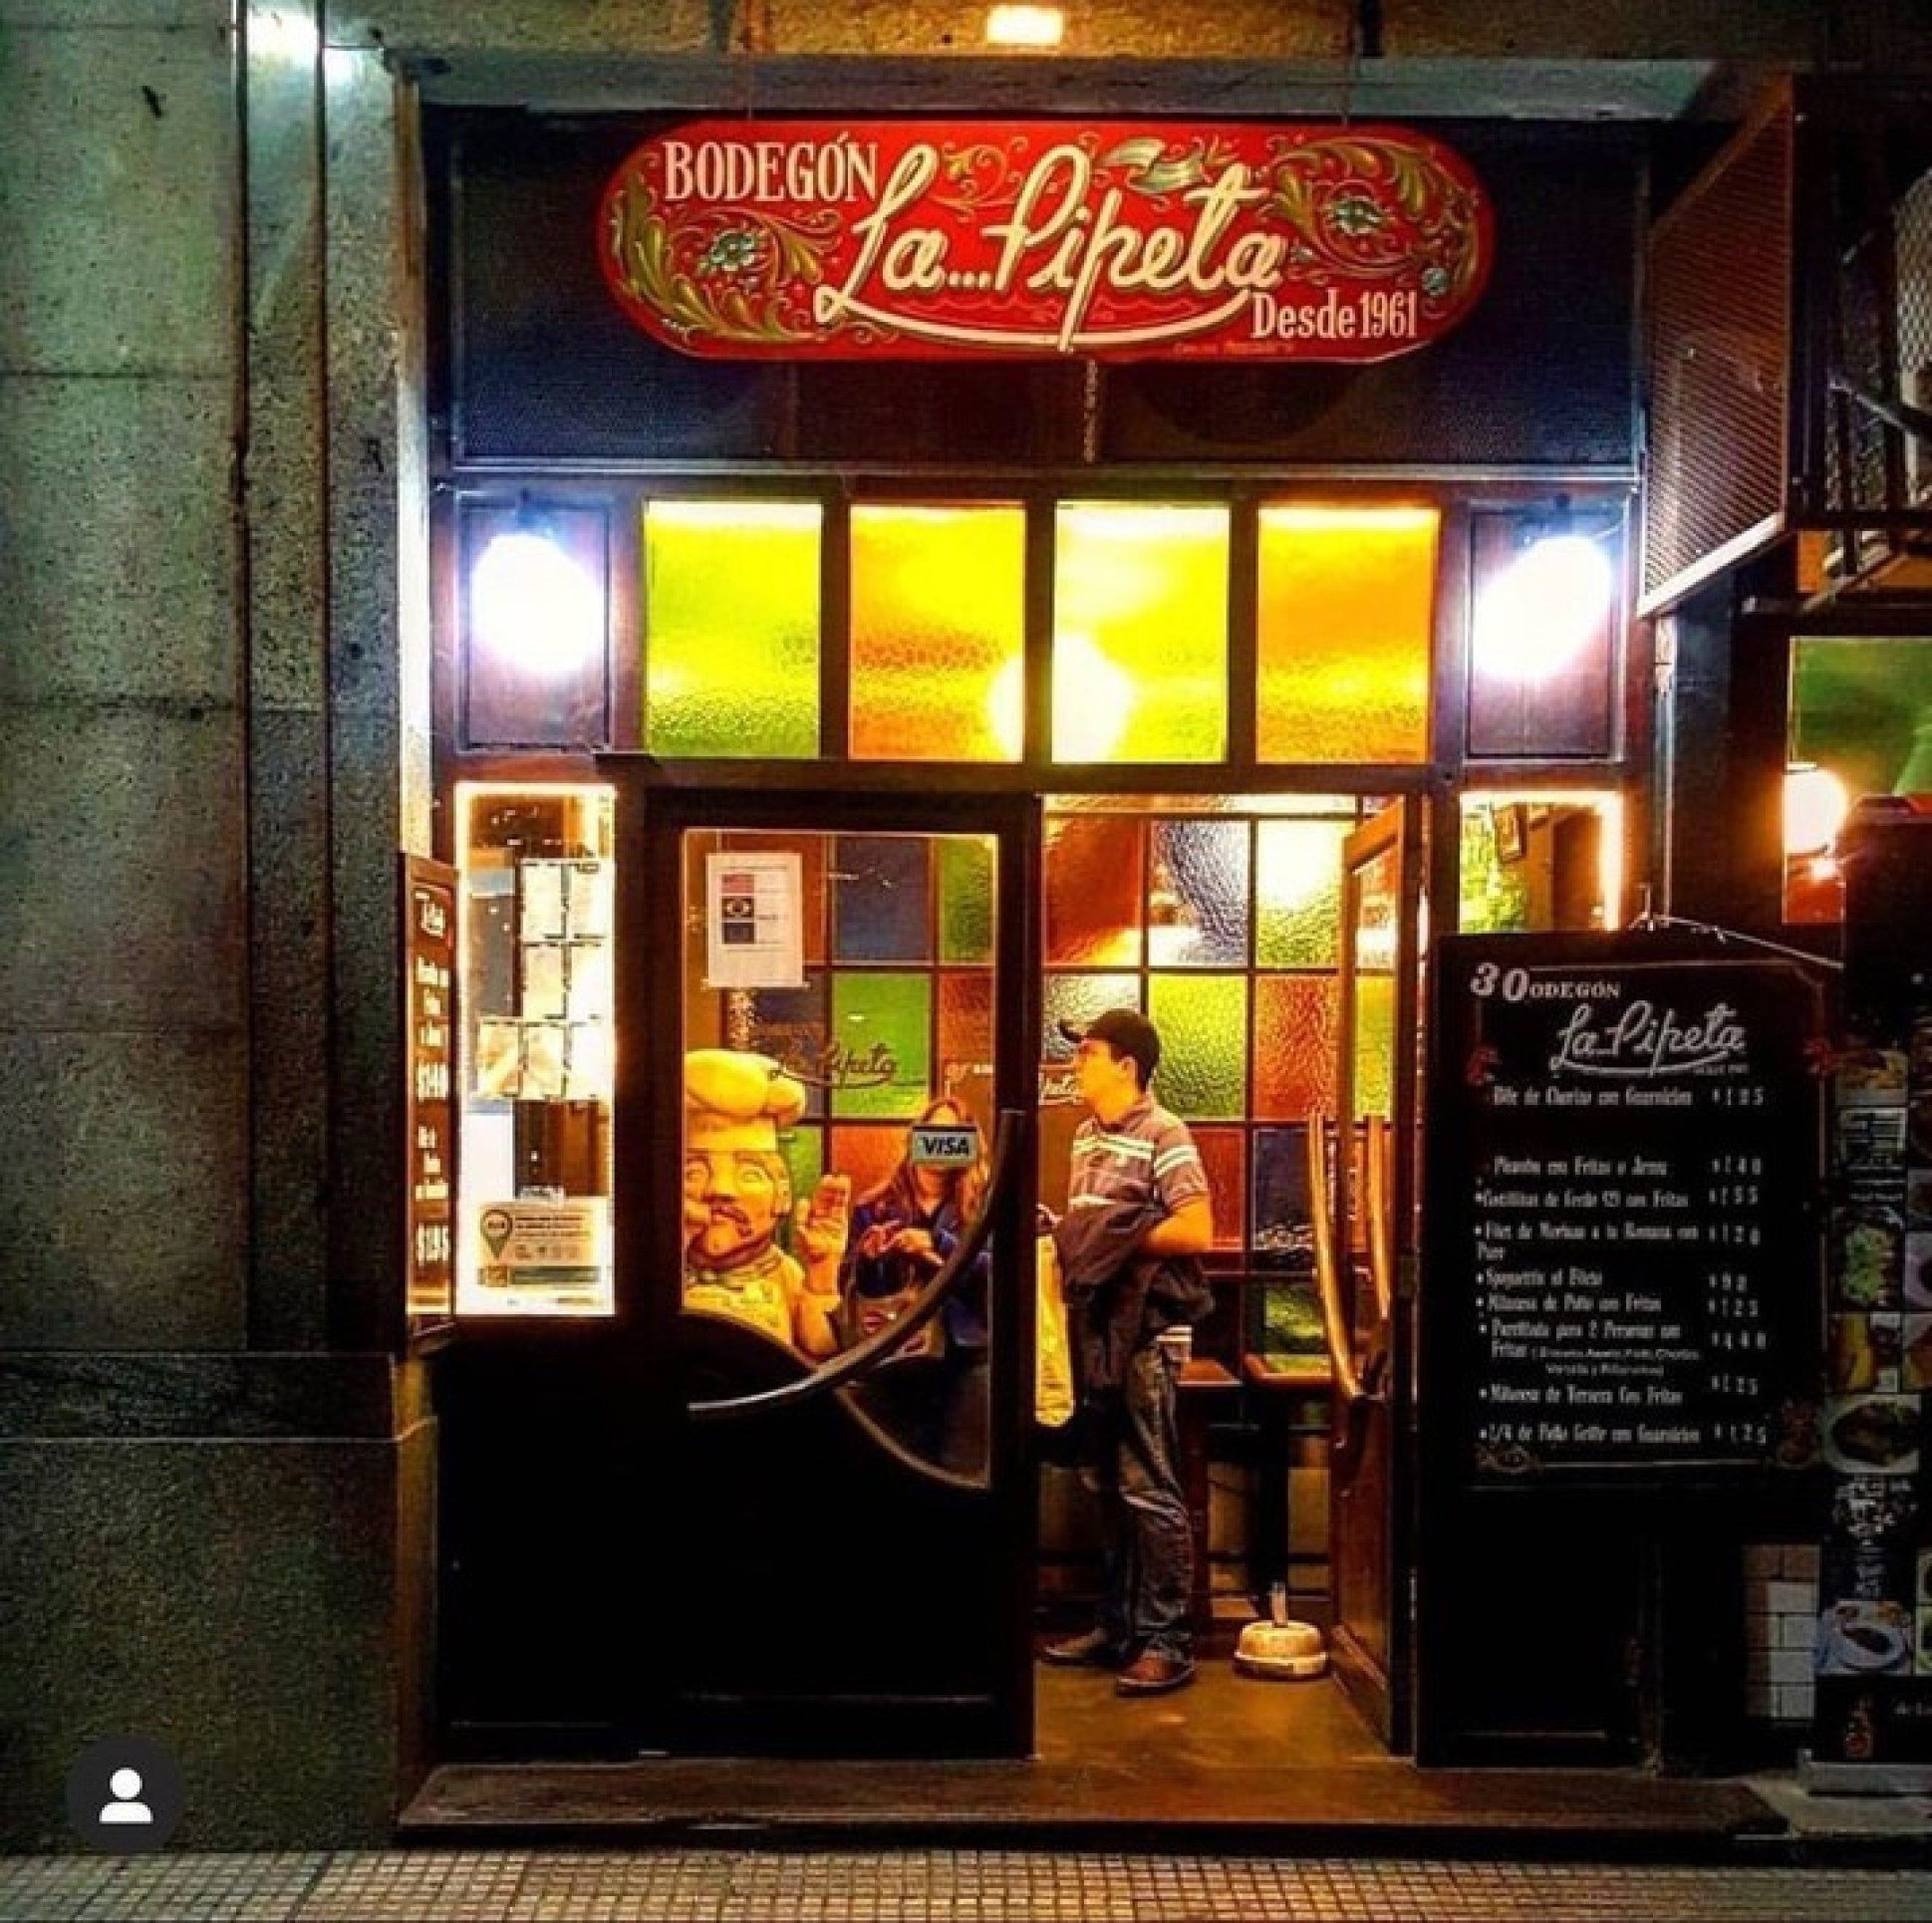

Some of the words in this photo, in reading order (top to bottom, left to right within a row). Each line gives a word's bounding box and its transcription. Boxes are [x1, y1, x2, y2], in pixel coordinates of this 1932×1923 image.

[663, 132, 879, 202] BODEGÓN
[1250, 288, 1357, 340] Desde
[1359, 291, 1418, 339] 1961
[1524, 1086, 1540, 1106] de
[1544, 1085, 1592, 1106] Chorizo
[1598, 1091, 1619, 1106] con
[923, 1136, 969, 1156] VISA
[1544, 1192, 1559, 1208] de
[1652, 1189, 1689, 1208] Fritas
[1542, 1294, 1558, 1312] de
[1625, 1293, 1663, 1312] Fritas
[1545, 1386, 1561, 1404] de
[1518, 1425, 1533, 1443] de
